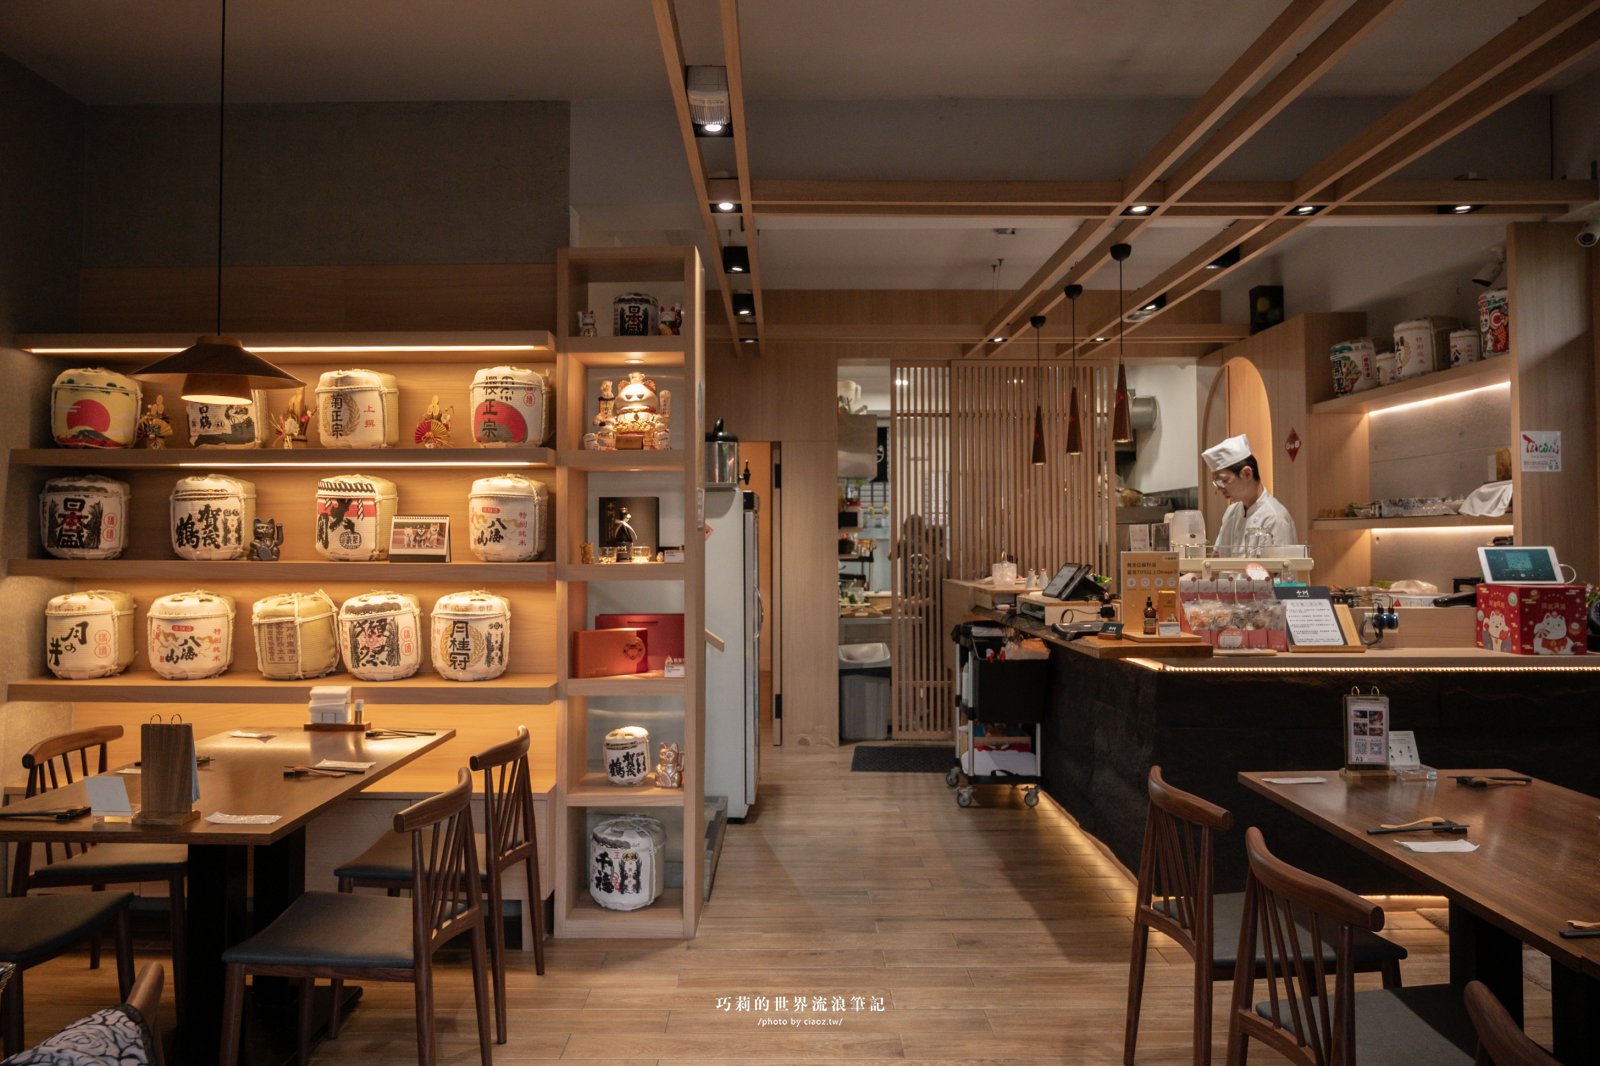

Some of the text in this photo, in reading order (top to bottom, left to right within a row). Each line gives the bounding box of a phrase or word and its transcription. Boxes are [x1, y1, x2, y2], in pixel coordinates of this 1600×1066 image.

[331, 392, 343, 439] 菊正宗
[176, 504, 222, 550] 賀茂鶴
[164, 635, 202, 665] 八海山
[448, 620, 471, 671] 月桂冠
